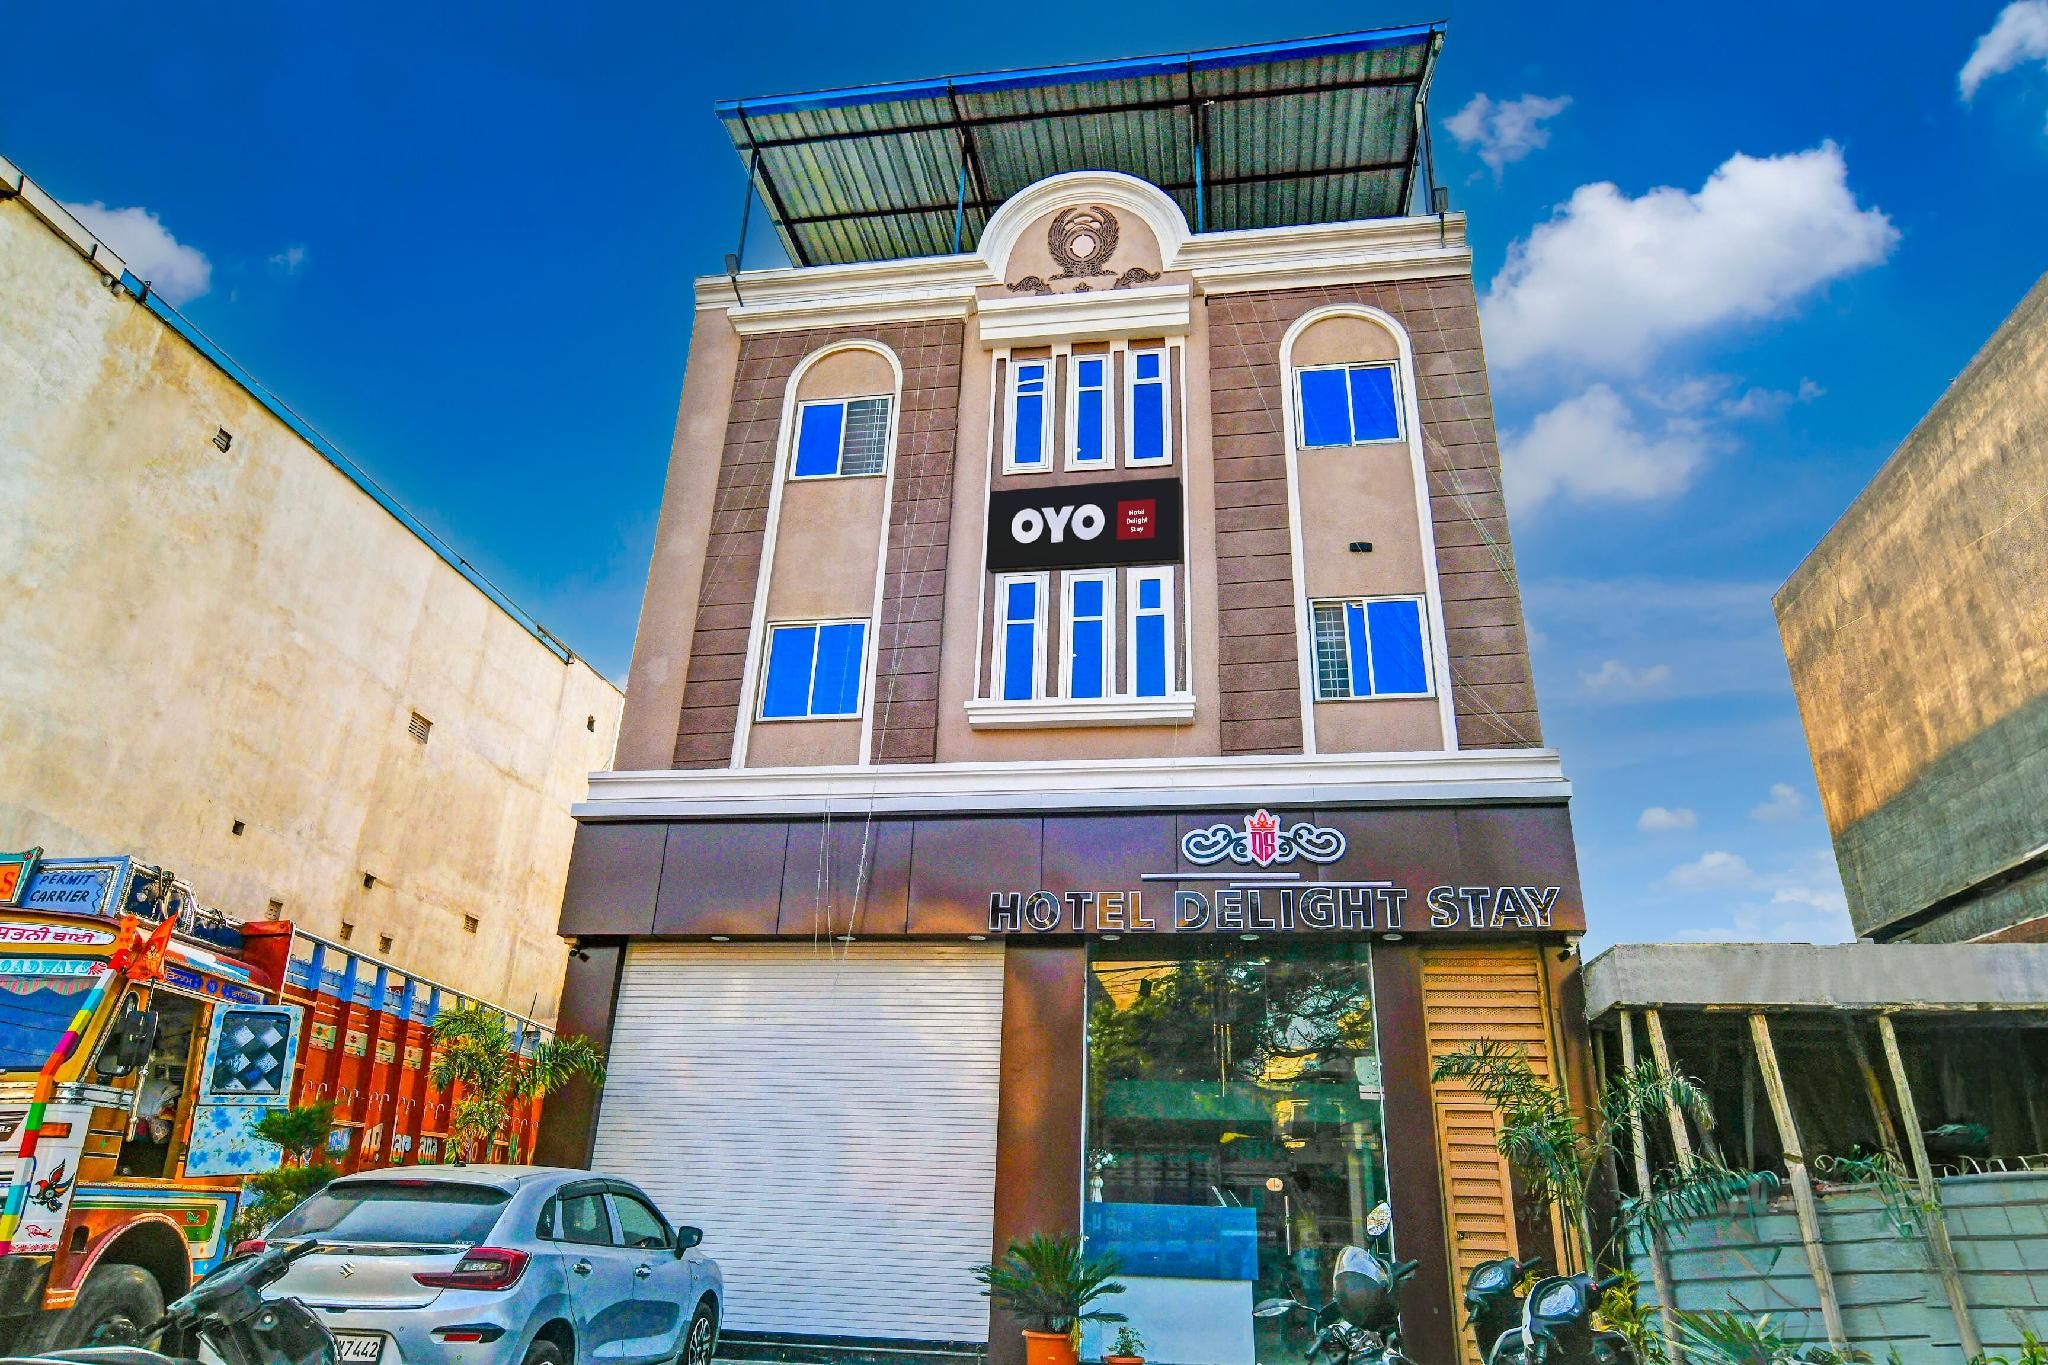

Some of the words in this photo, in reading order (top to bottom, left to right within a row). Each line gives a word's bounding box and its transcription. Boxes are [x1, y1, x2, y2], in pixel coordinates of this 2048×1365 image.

[1011, 503, 1106, 544] OYO
[39, 873, 96, 886] PERMIT
[29, 889, 91, 903] CARRIER
[988, 890, 1156, 931] HOTEL
[1174, 887, 1408, 930] DELIGHT
[1426, 885, 1561, 930] STAY
